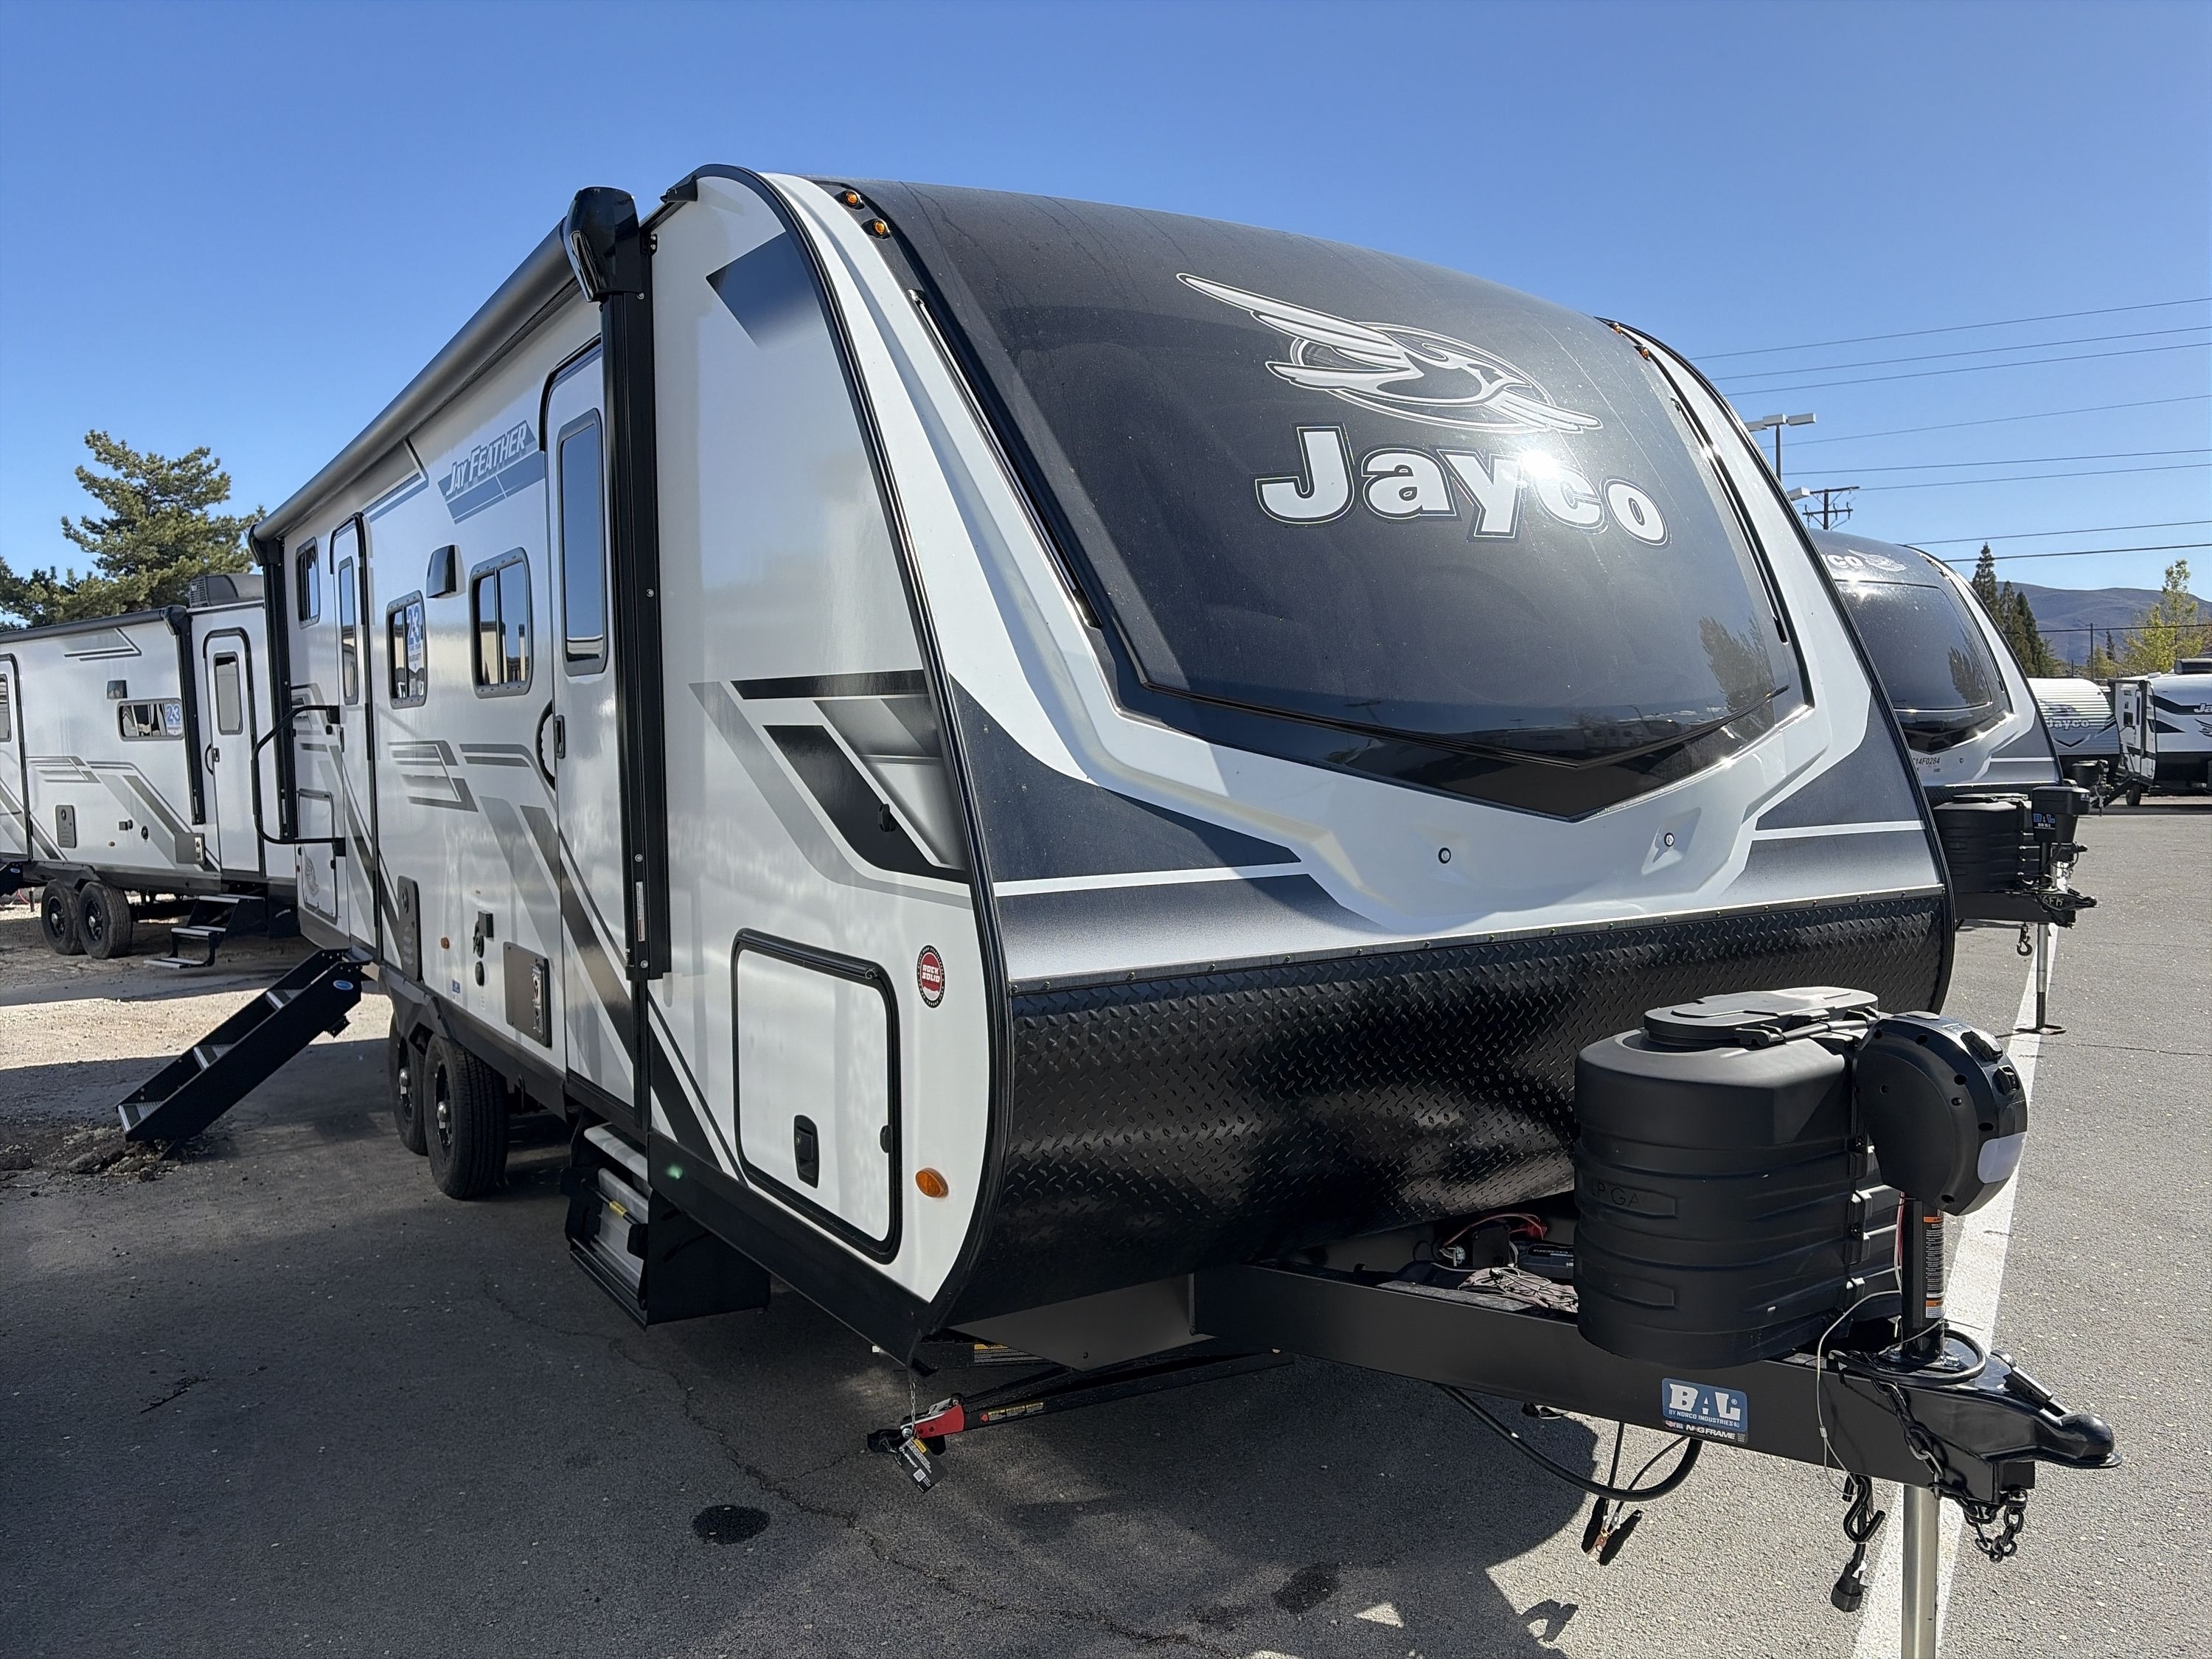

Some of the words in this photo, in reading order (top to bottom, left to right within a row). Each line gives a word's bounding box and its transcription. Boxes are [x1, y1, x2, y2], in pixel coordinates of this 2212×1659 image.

[445, 462, 467, 496] JAY
[469, 422, 527, 483] FEATHER
[1255, 425, 1669, 547] Jayco
[2047, 717, 2090, 731] Jayco
[922, 964, 939, 975] ROCK
[922, 973, 940, 983] SOLID
[1676, 1409, 1697, 1420] NORCO
[1698, 1415, 1733, 1427] INDUSTRIES
[1705, 1428, 1736, 1440] FRAME
